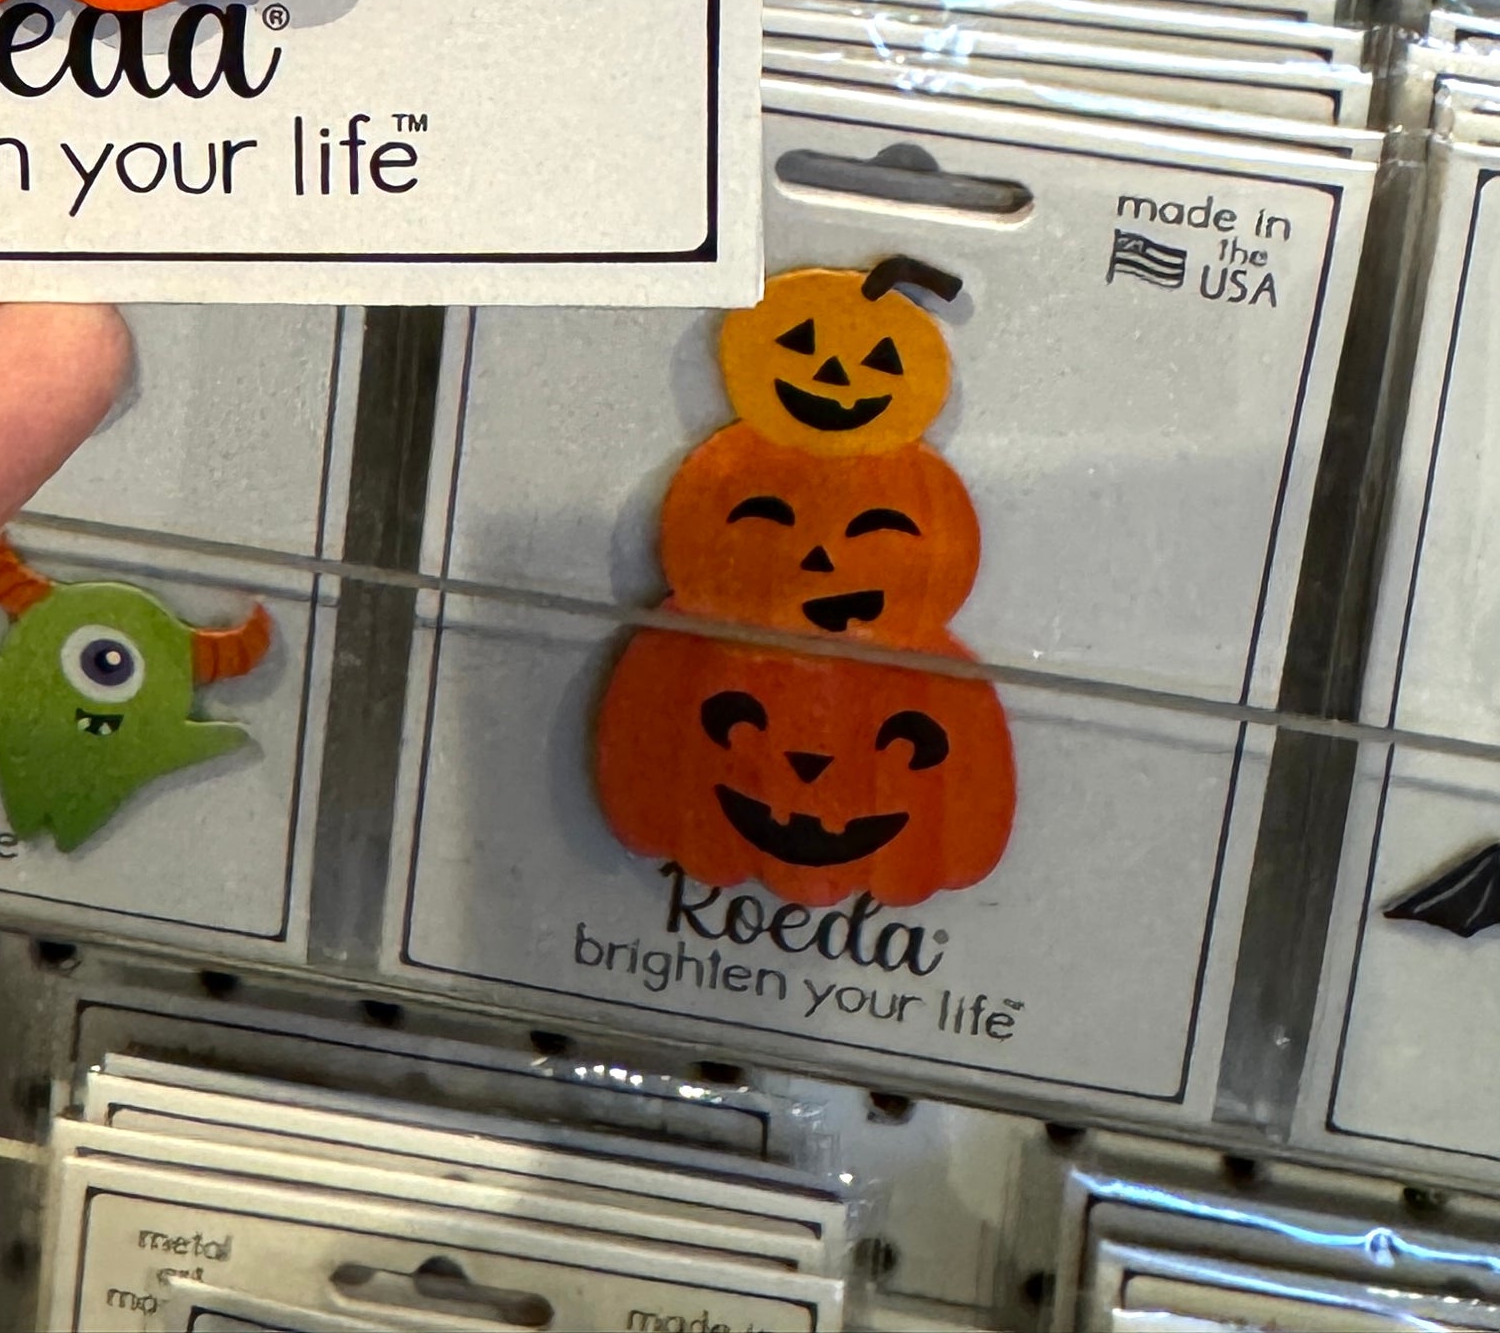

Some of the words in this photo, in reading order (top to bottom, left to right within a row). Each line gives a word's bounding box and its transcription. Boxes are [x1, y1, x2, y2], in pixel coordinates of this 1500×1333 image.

[60, 141, 258, 217] your
[1117, 195, 1238, 231] made
[1255, 208, 1292, 241] in
[1219, 236, 1268, 267] the
[1200, 264, 1278, 308] USA
[575, 922, 788, 1001] brighten
[804, 979, 926, 1022] your
